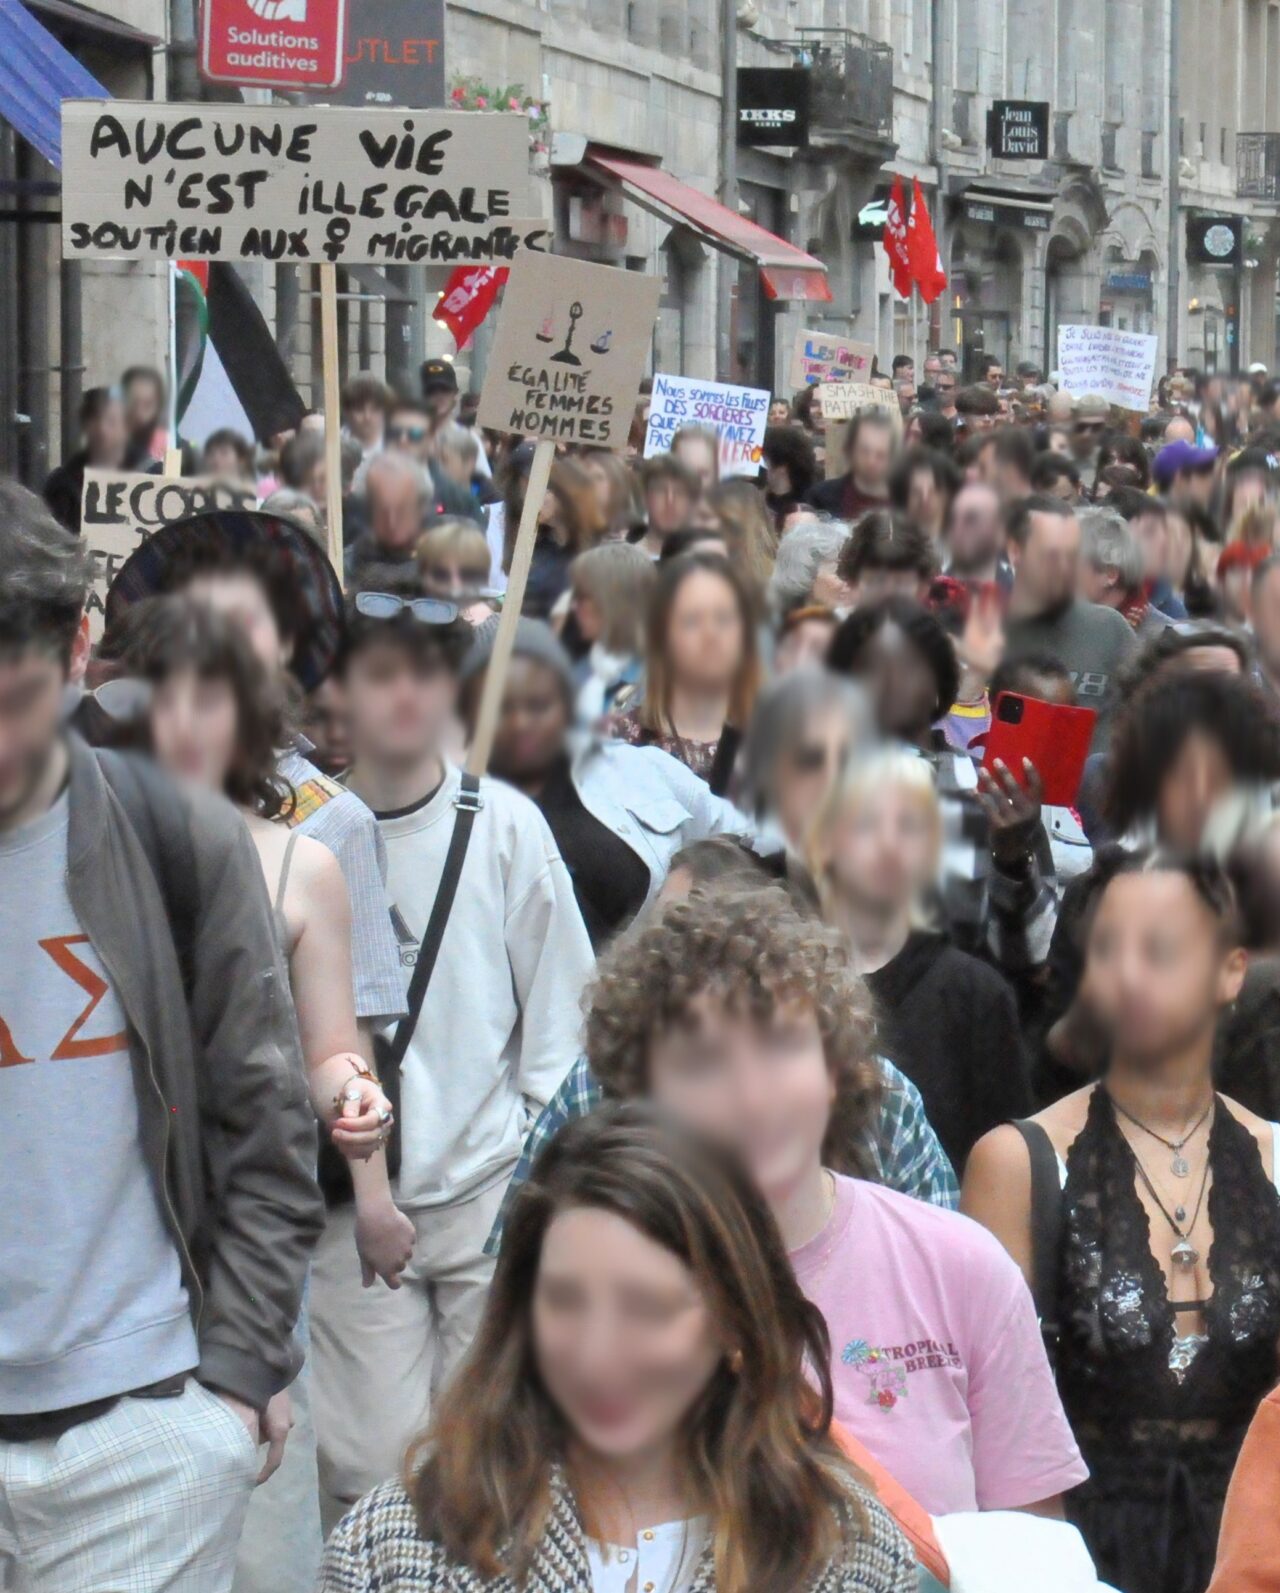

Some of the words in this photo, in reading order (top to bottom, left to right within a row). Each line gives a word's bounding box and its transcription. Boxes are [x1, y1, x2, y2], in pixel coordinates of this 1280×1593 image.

[228, 27, 318, 50] Solutions
[345, 38, 439, 64] UTLET
[227, 52, 318, 72] auditives
[740, 109, 796, 122] IKKS
[1001, 107, 1031, 122] Jean
[90, 115, 317, 164] AUCUNE
[1002, 121, 1038, 137] Louis
[1002, 137, 1038, 153] David
[125, 168, 270, 214] N'EST
[240, 227, 310, 259] AUX
[508, 362, 592, 393] ÉGALITÉ
[526, 389, 613, 415] FEMMES
[826, 385, 875, 399] SMASH
[879, 390, 898, 404] THE
[664, 399, 687, 415] DES
[510, 408, 610, 441] HOMMES
[649, 413, 676, 430] QUE
[649, 430, 672, 448] PAS
[84, 481, 128, 524] LE
